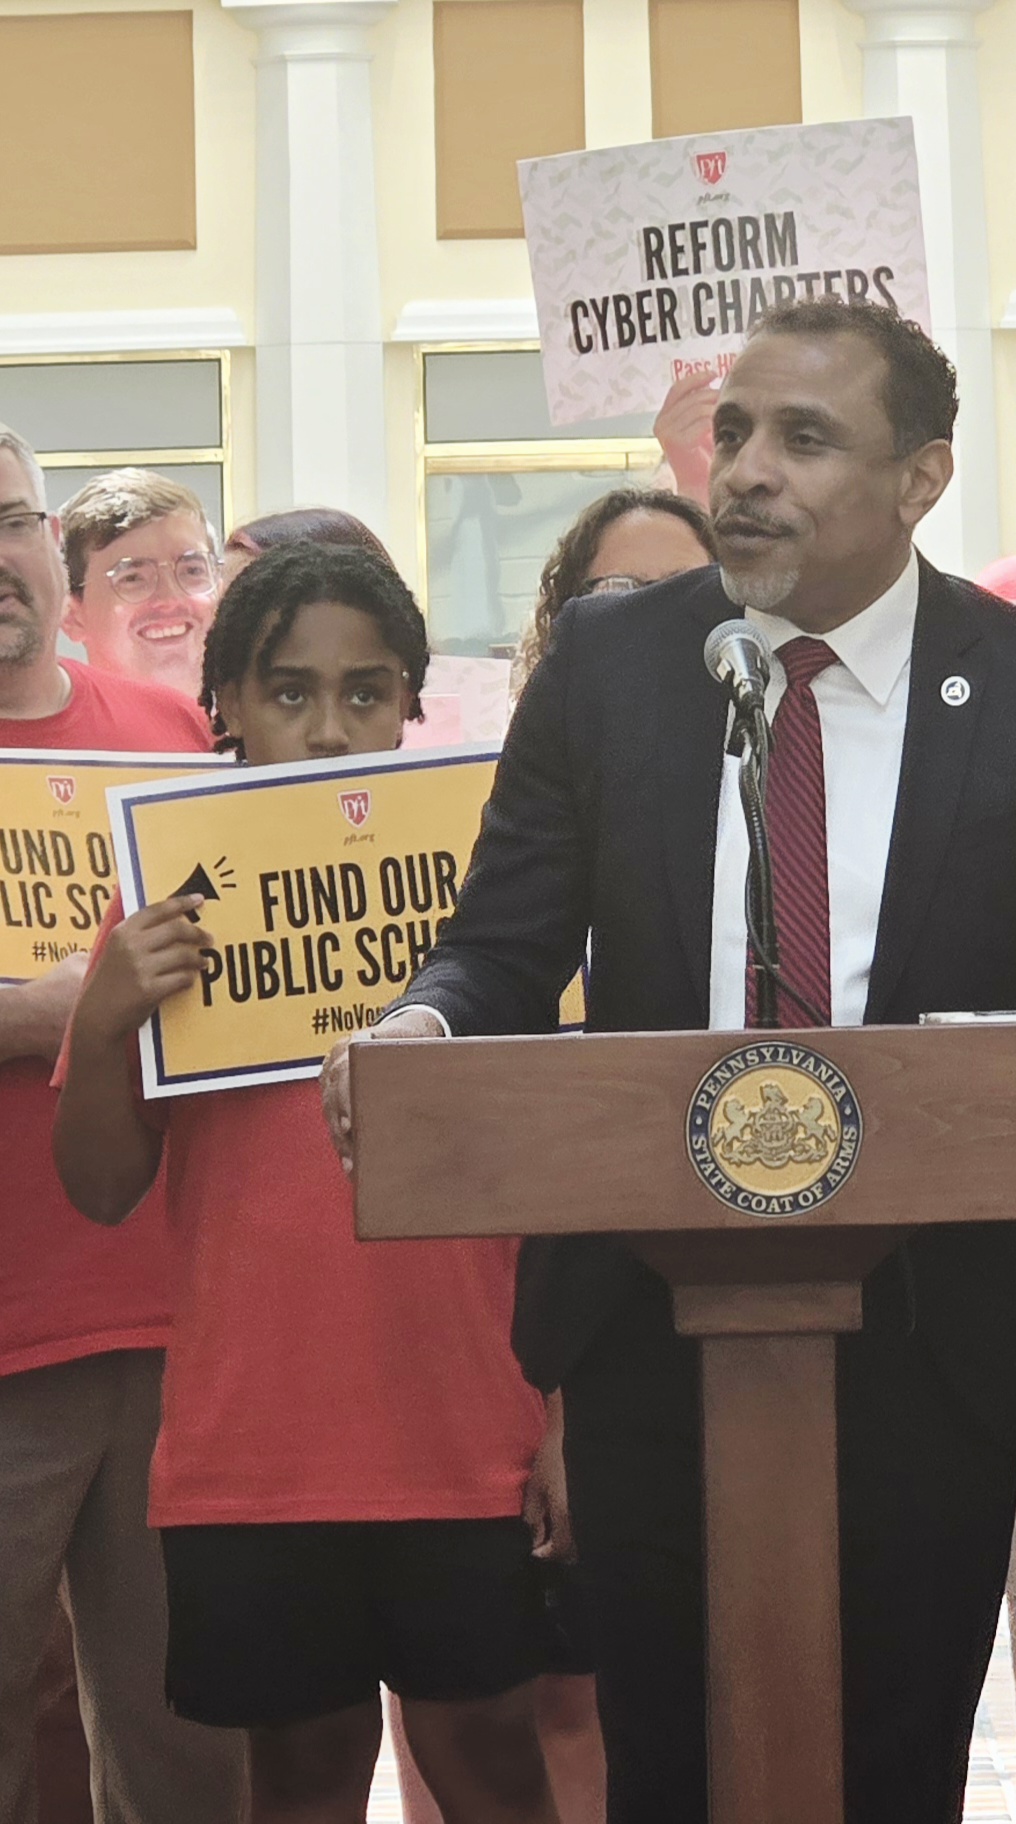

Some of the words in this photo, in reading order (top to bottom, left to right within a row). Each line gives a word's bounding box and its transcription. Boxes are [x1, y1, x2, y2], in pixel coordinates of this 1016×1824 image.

[643, 211, 798, 281] REFORM
[570, 287, 681, 354] CYBER
[86, 832, 117, 878] O
[66, 883, 117, 930] SC
[259, 862, 367, 932] FUND
[379, 850, 459, 917] OUR
[199, 931, 343, 1008] PUBLIC
[696, 1046, 847, 1111] PENNSYLVANIA
[692, 1135, 736, 1199] STATE
[737, 1190, 794, 1213] COAT
[798, 1181, 825, 1207] OF
[828, 1126, 858, 1188] ARMS
